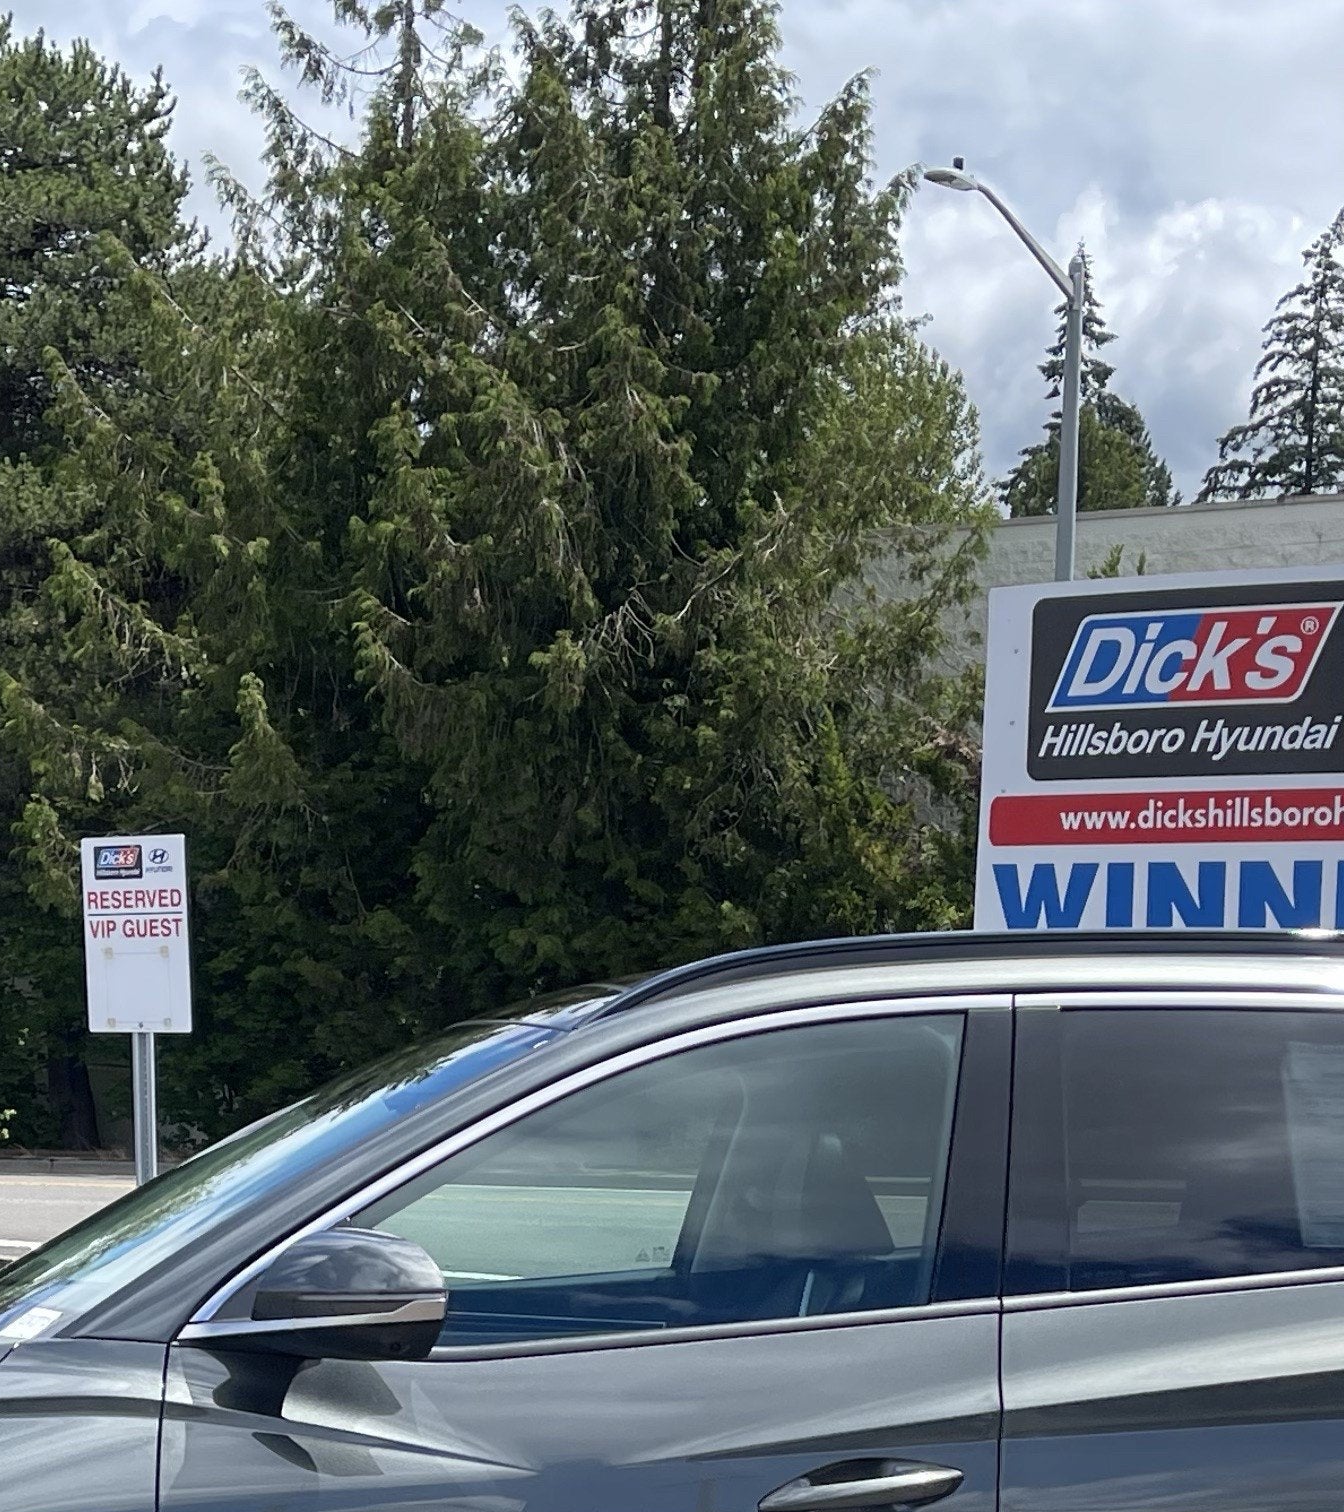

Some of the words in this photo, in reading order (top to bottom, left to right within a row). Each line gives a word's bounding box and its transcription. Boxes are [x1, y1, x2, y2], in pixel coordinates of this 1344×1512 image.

[1067, 616, 1303, 697] Dick's
[1038, 722, 1185, 757] Hillsboro
[1190, 715, 1343, 761] Hyundai
[87, 889, 181, 909] RESERVED
[89, 920, 116, 938] VIP
[123, 918, 182, 937] GUEST
